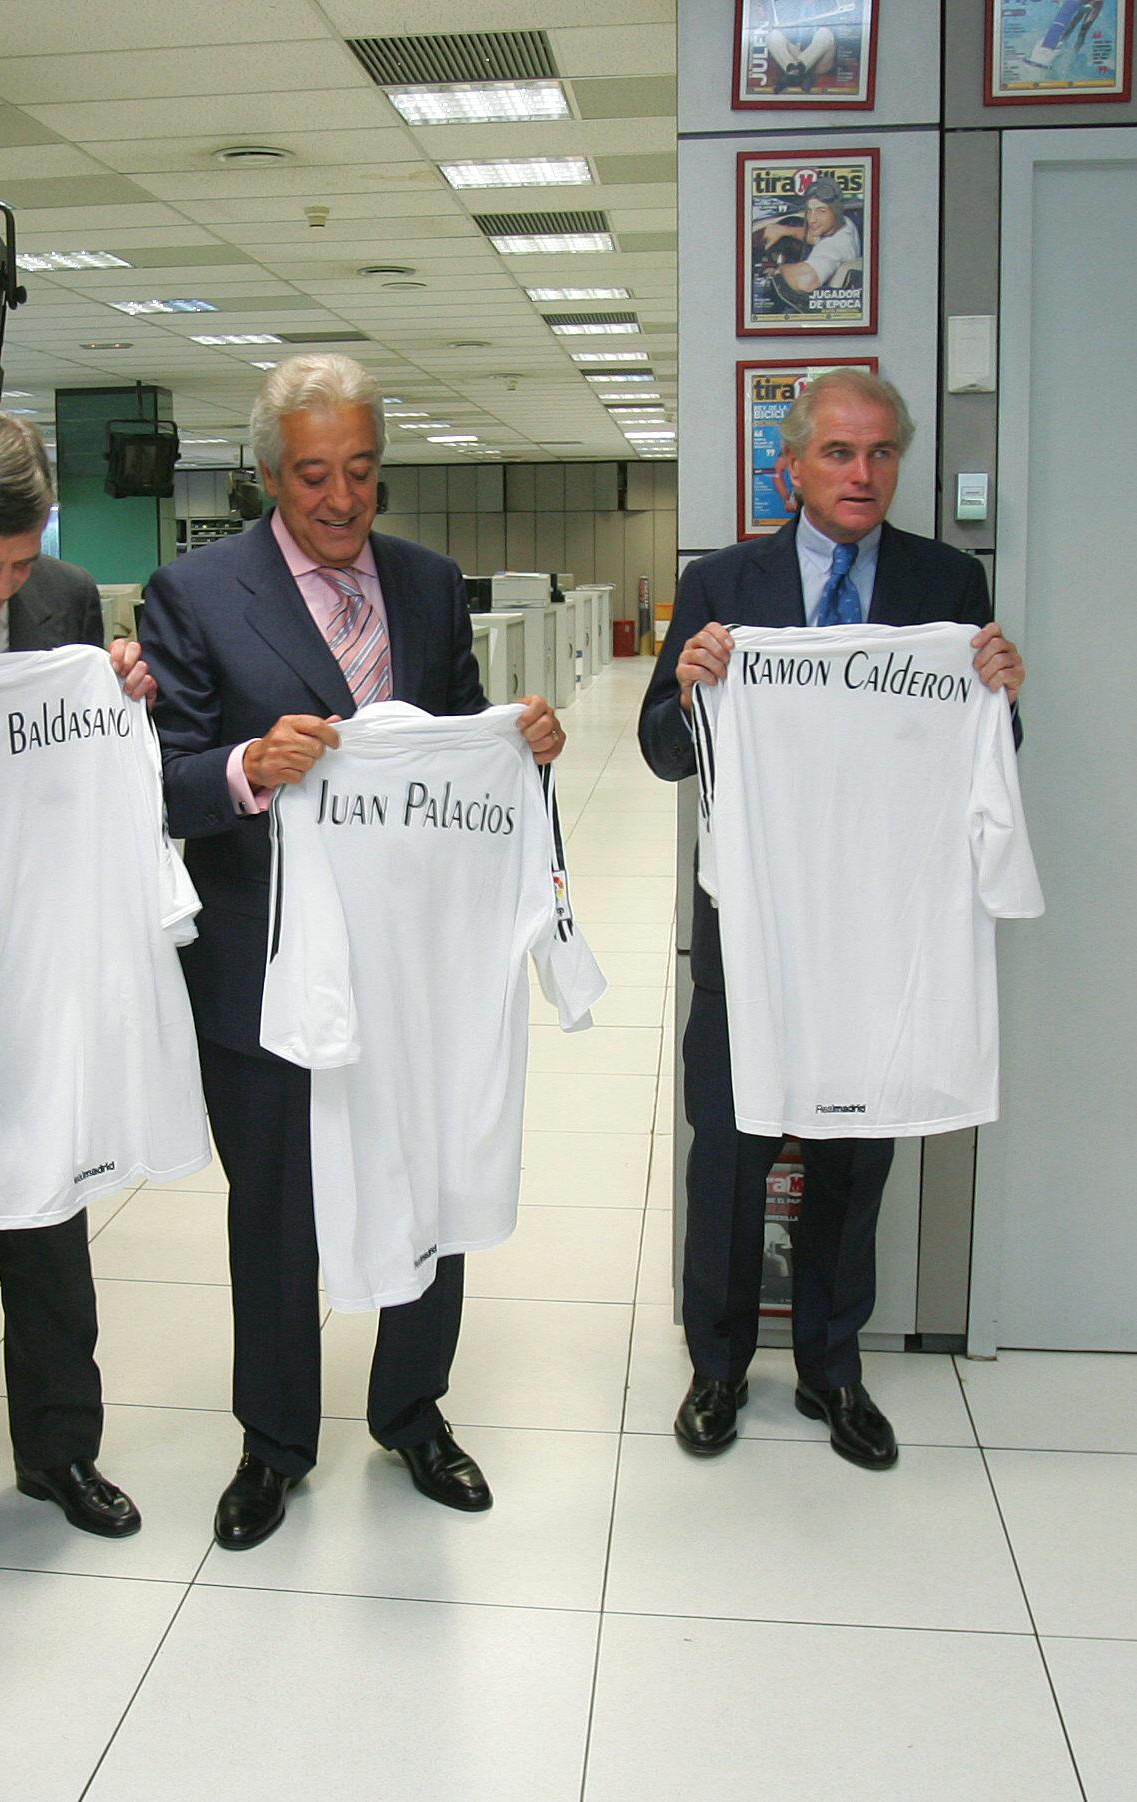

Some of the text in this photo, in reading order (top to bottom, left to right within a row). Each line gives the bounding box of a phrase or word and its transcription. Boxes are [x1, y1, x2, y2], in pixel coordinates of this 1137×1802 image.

[808, 289, 861, 299] JUGADOR
[809, 301, 823, 310] DE
[742, 651, 832, 686] RAMON
[317, 779, 389, 827] JUAN
